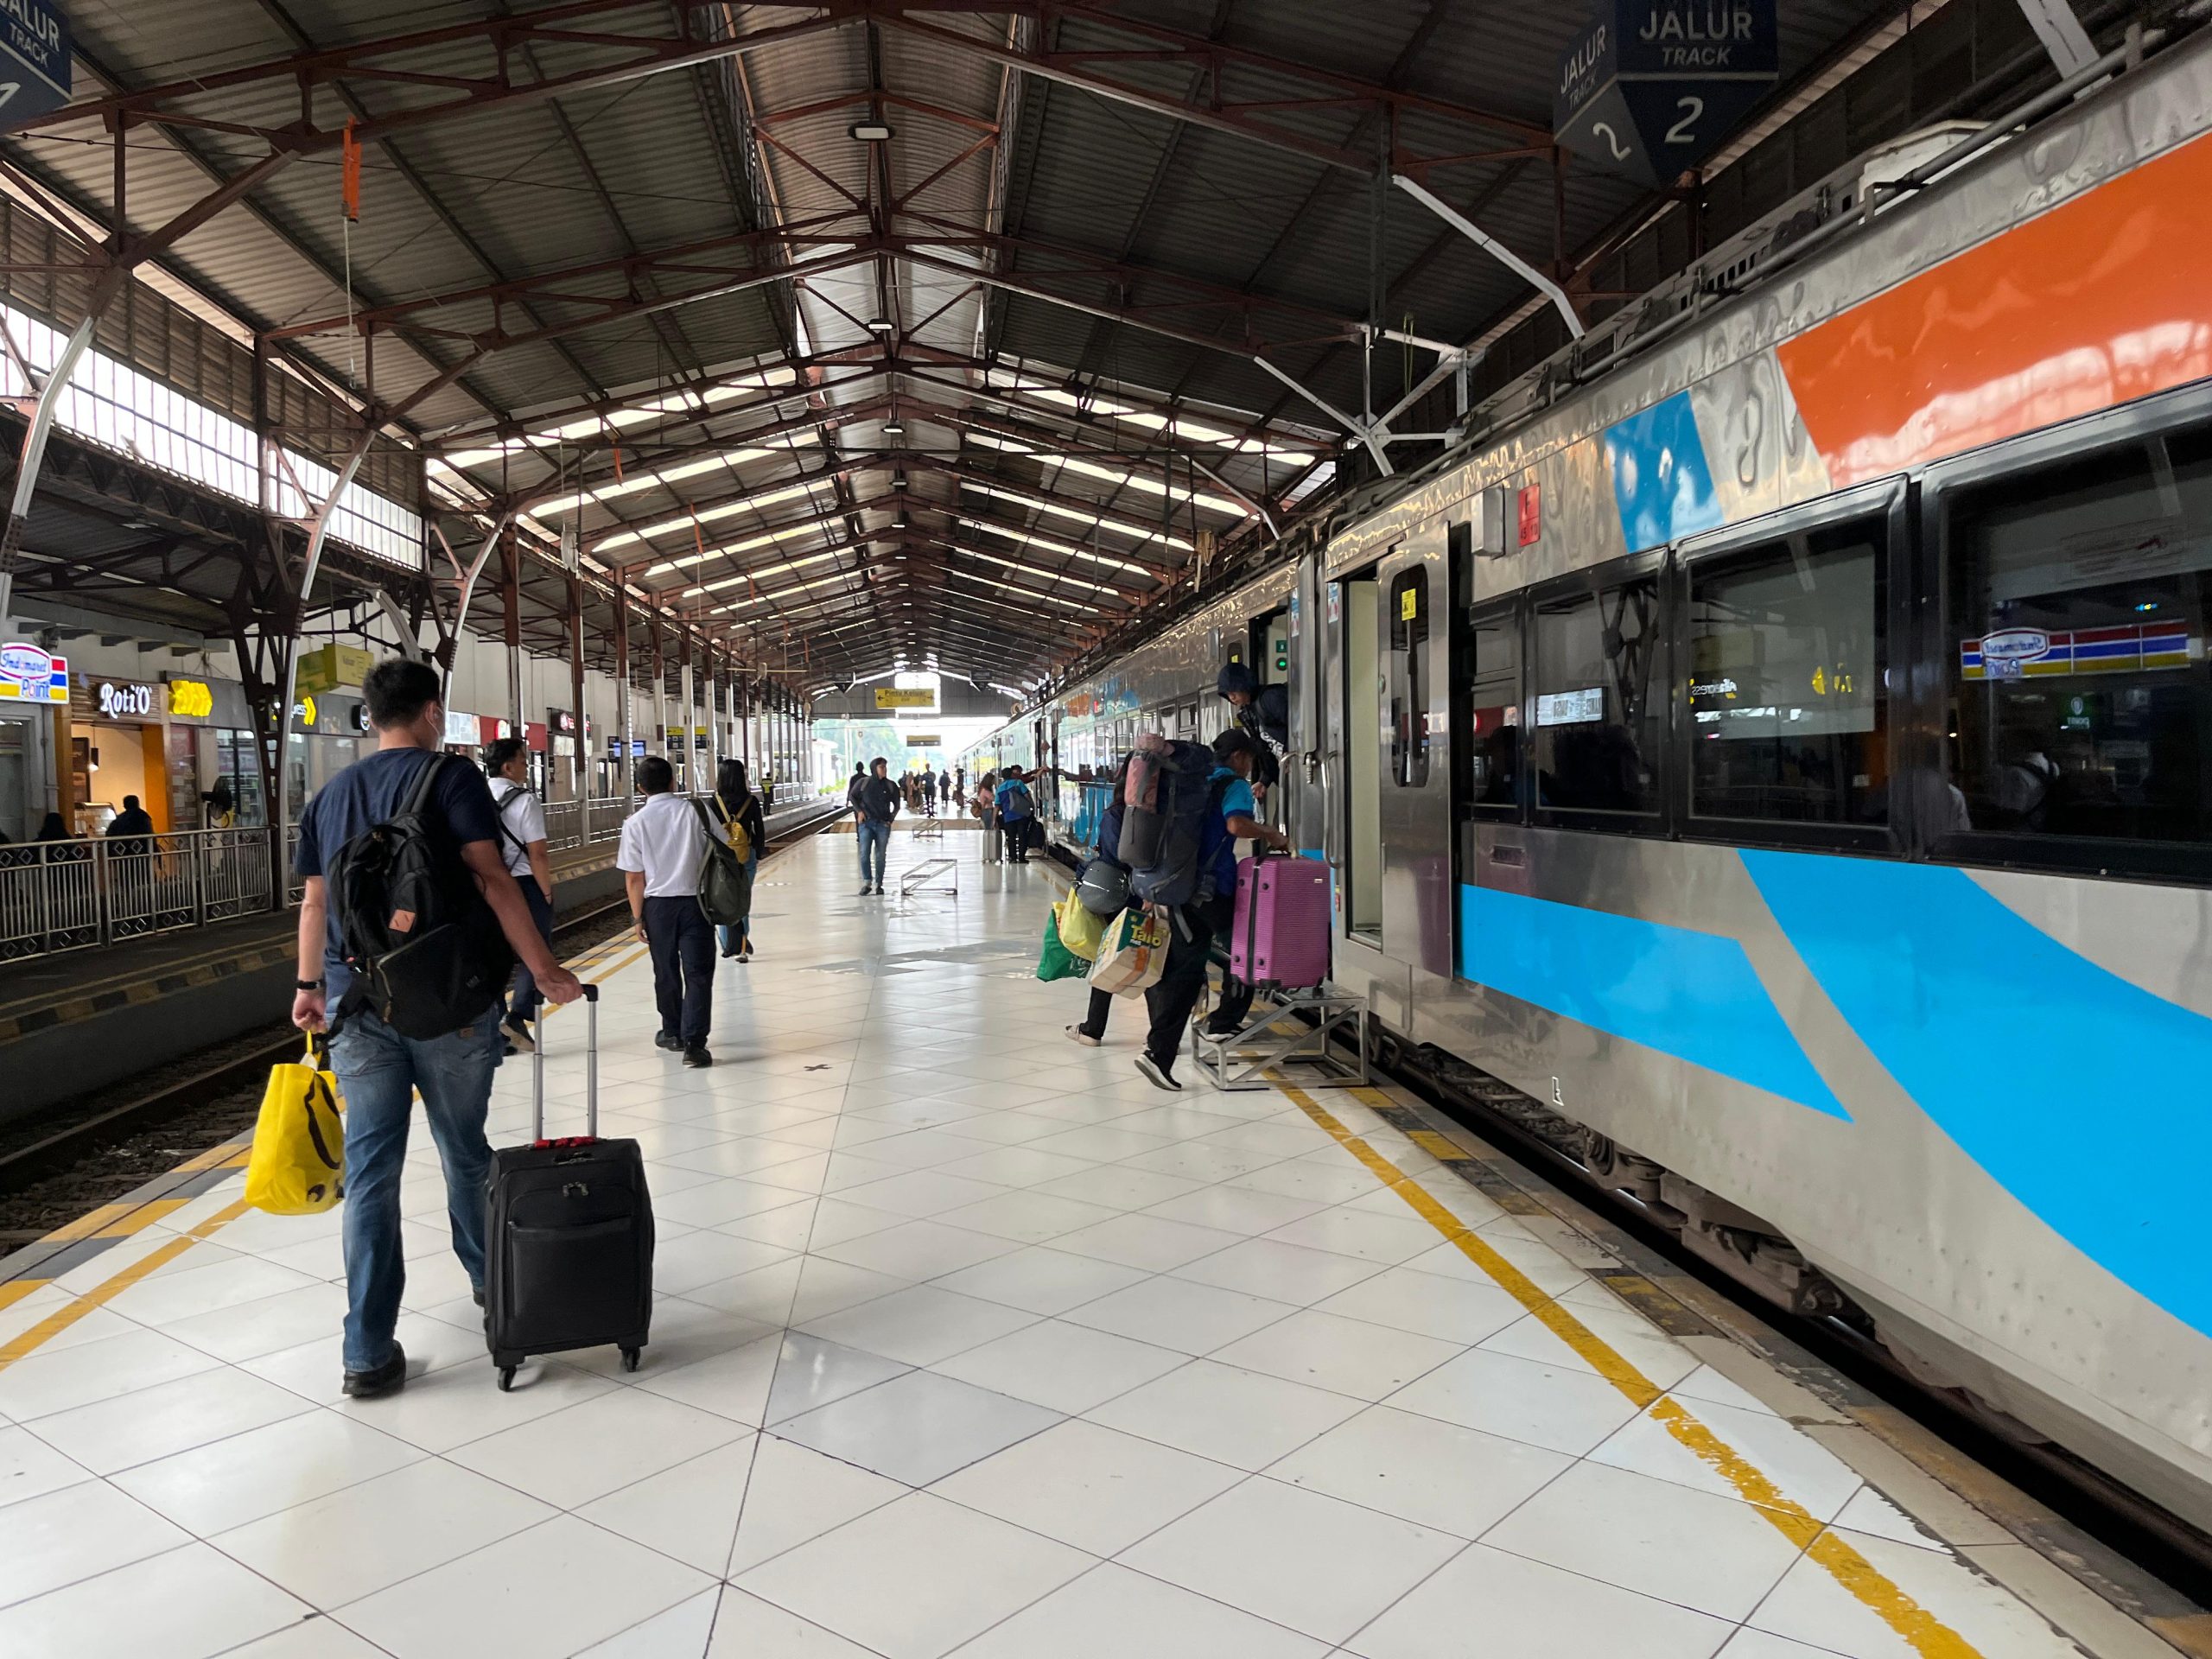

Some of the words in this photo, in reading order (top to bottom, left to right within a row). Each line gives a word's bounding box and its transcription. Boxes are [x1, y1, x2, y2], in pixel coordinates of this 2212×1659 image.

[0, 0, 60, 52] ALUR
[10, 22, 48, 68] TRACK
[1640, 10, 1753, 41] JALUR
[1560, 24, 1606, 95] JALUR
[1662, 47, 1732, 67] TRACK
[1568, 69, 1598, 111] TRACK
[1664, 97, 1704, 143] 2
[1592, 122, 1631, 162] 2
[22, 678, 50, 698] Point
